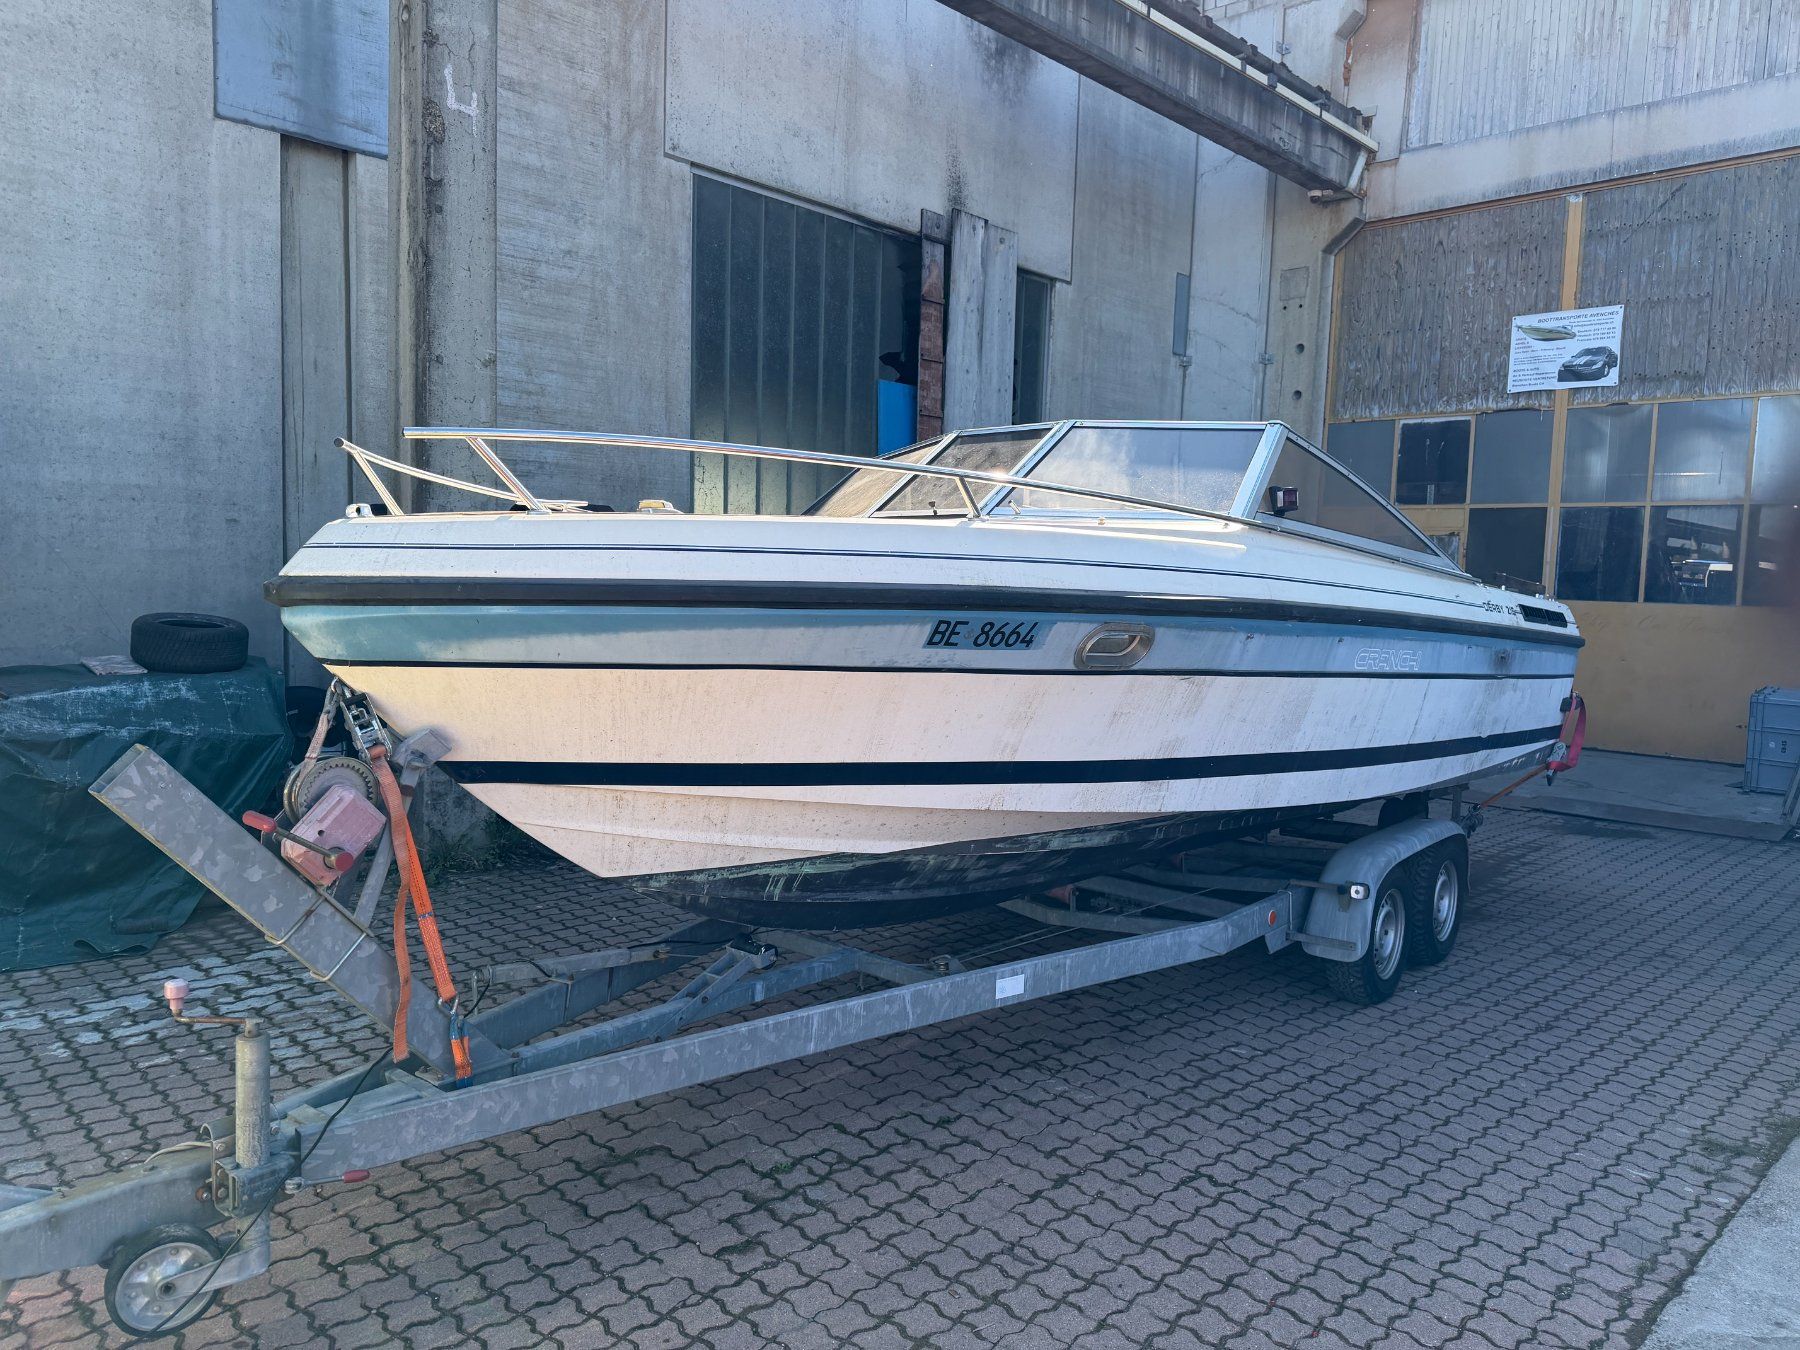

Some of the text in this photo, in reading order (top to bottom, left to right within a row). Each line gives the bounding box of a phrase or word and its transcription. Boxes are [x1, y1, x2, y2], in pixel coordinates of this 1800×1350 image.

[444, 63, 479, 137] 4
[1589, 311, 1619, 319] AVENCHES
[926, 619, 1040, 648] BE 8664
[1354, 647, 1423, 671] CRANCHI
